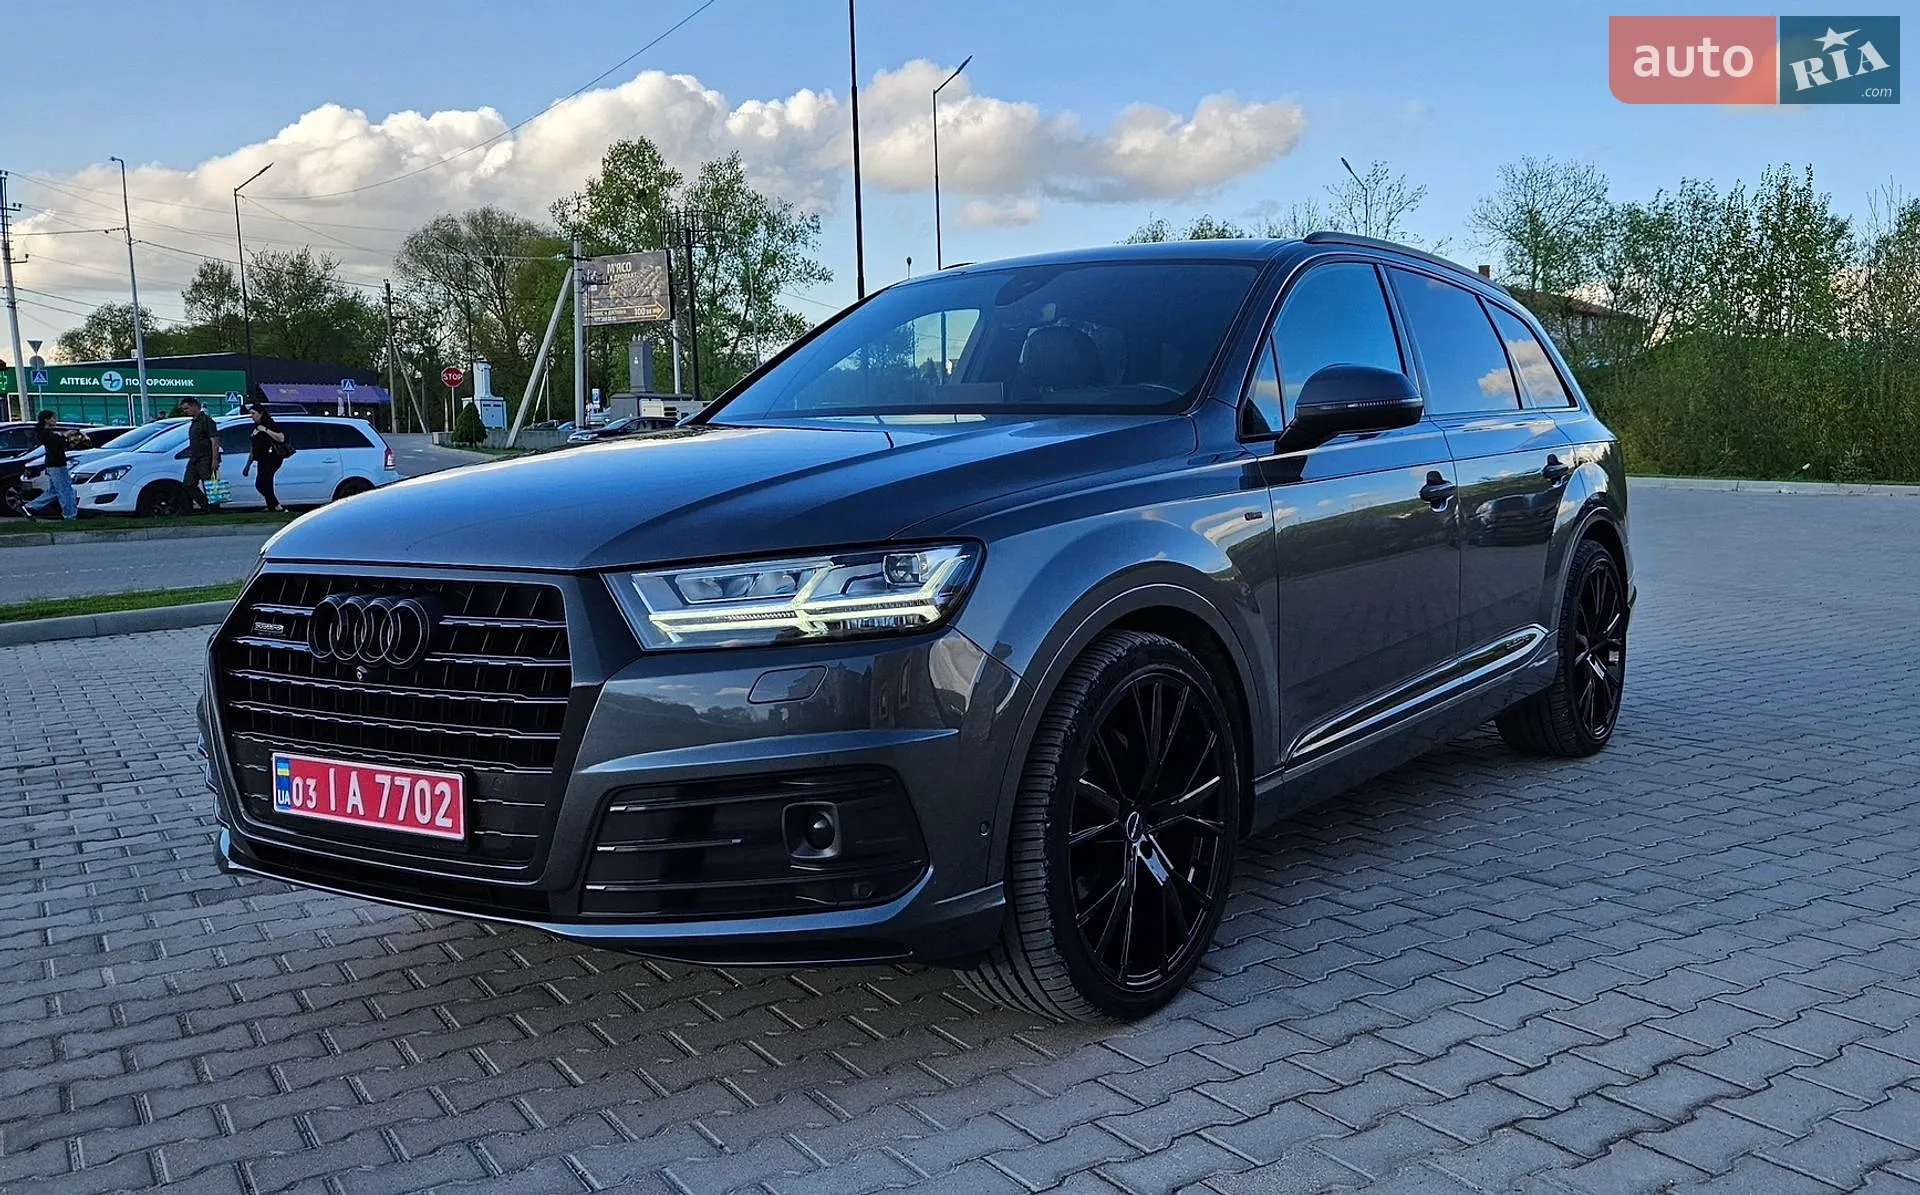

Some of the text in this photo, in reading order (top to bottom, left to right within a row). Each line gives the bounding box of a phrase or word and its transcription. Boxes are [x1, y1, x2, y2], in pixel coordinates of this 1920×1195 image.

[60, 377, 194, 387] АПТЕКА ПООРОЖНИК
[443, 373, 463, 381] STOP
[277, 789, 291, 805] UA
[292, 776, 317, 809] 03
[375, 773, 453, 828] 7702
